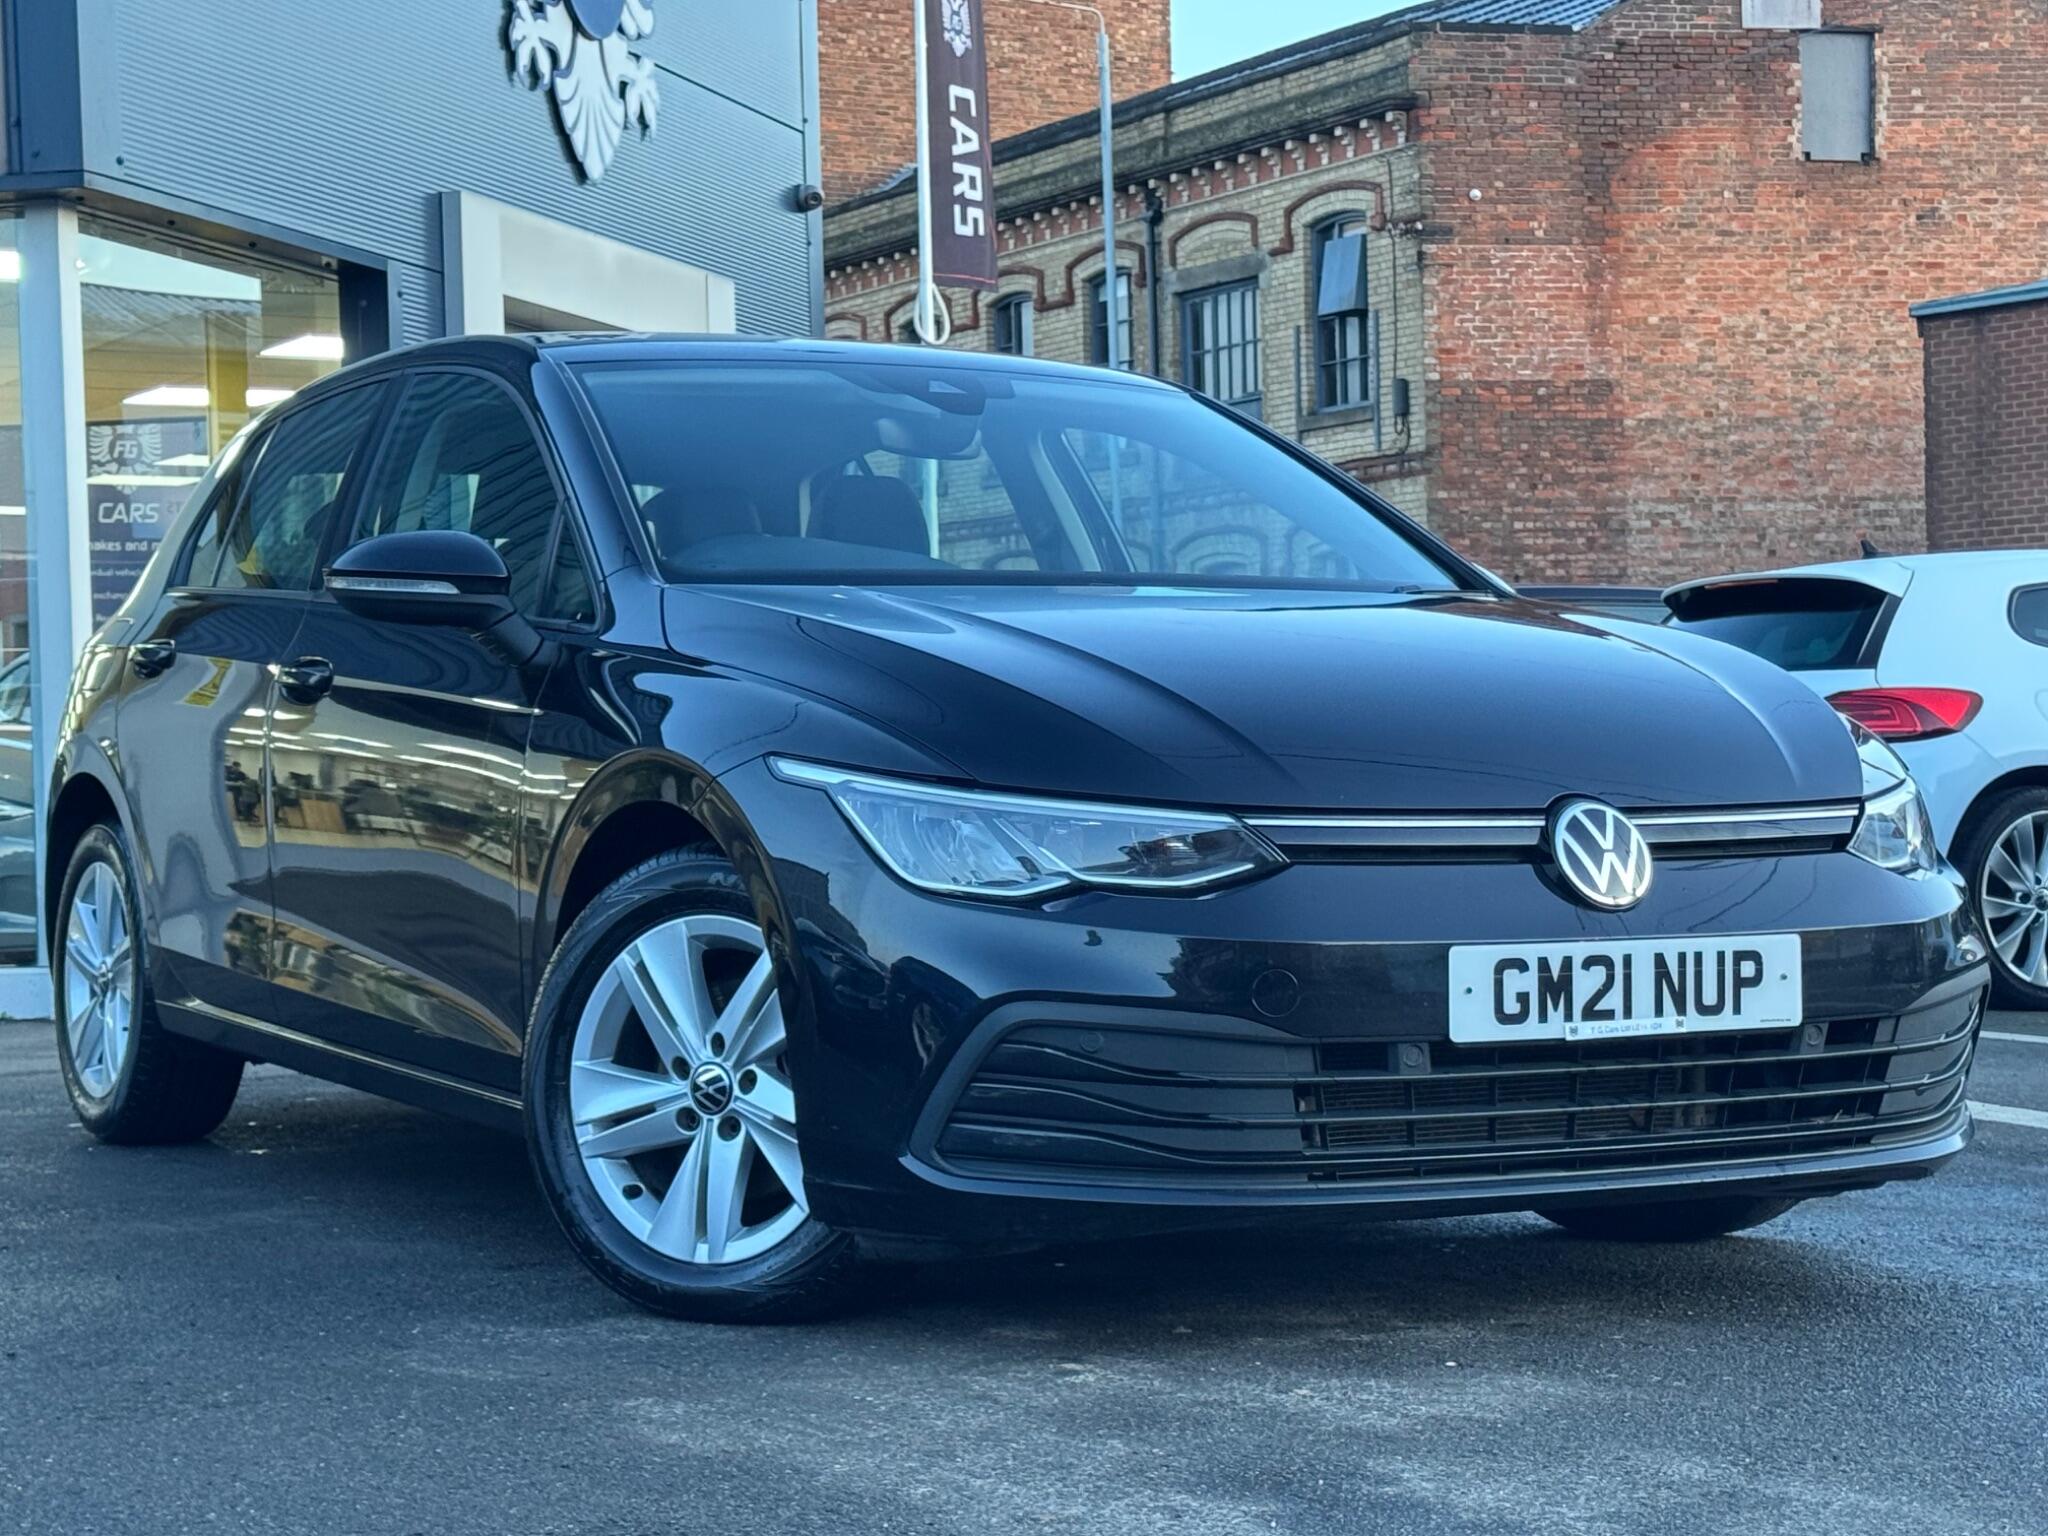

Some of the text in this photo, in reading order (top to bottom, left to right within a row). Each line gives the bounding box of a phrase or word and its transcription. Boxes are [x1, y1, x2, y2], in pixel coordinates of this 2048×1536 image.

[949, 84, 986, 237] CARS
[113, 440, 138, 459] FG
[98, 502, 160, 523] CARS
[125, 540, 148, 551] and
[1493, 950, 1764, 1026] GM21 NUP
